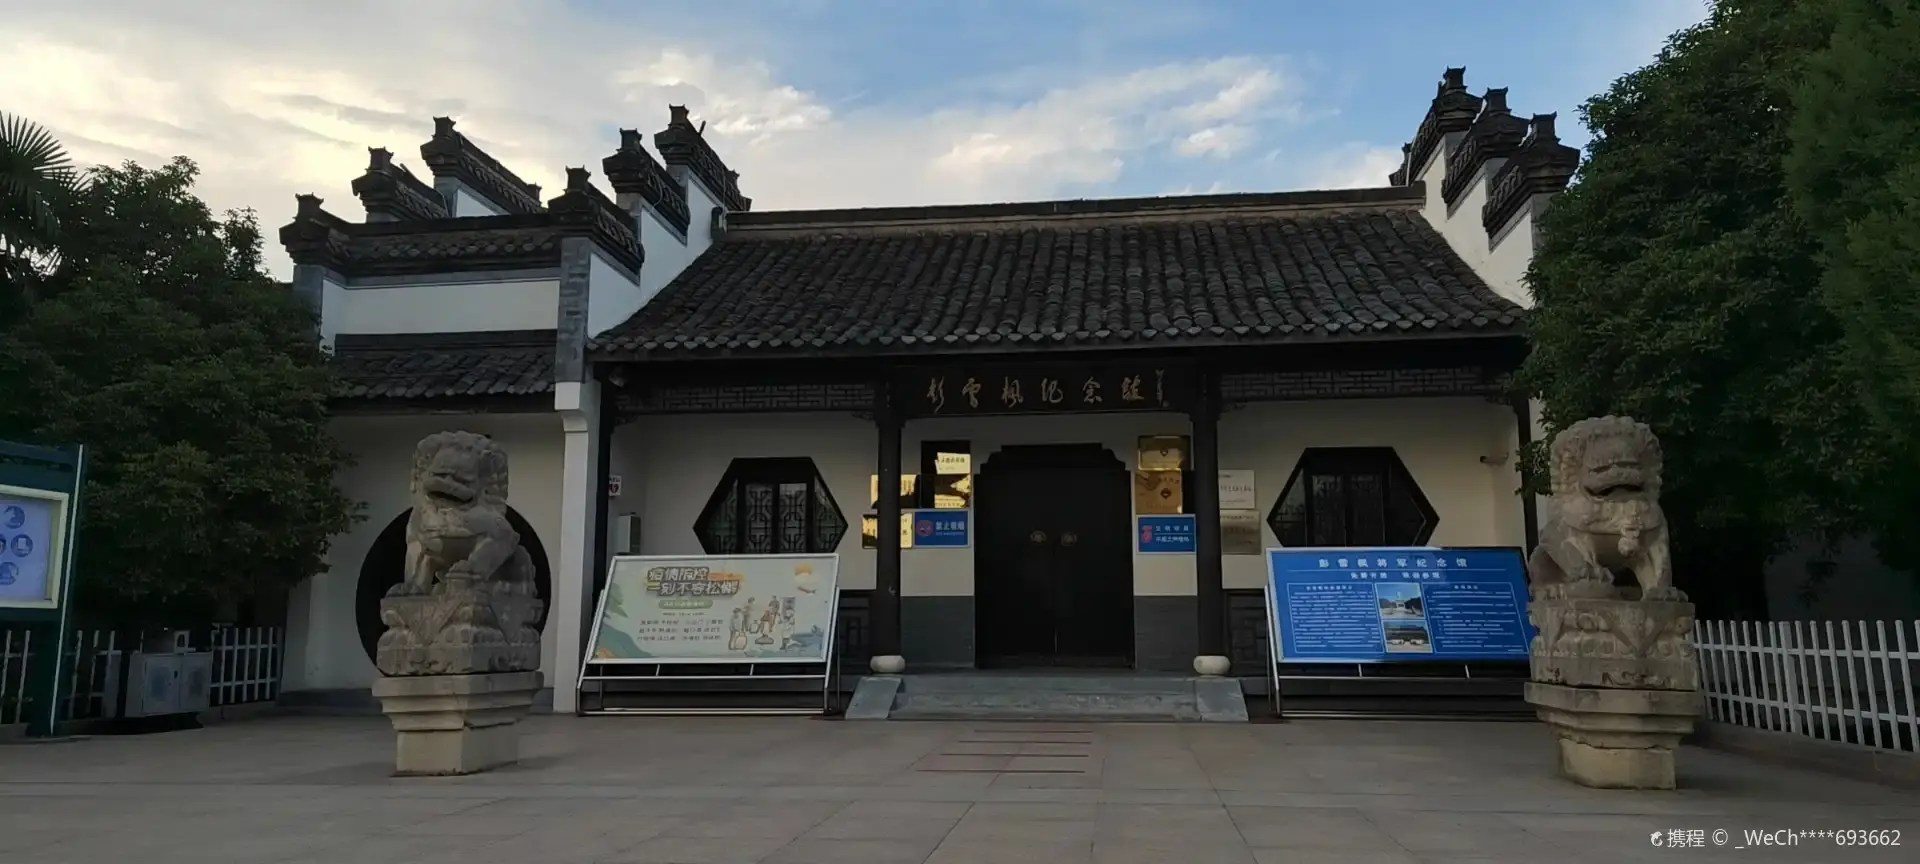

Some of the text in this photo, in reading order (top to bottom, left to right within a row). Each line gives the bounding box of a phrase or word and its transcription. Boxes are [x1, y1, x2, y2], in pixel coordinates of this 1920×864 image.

[1318, 558, 1468, 568] 彭雪枫将军纪念馆
[648, 567, 709, 581] 疫情防控
[646, 580, 740, 596] 一刻不容松懈
